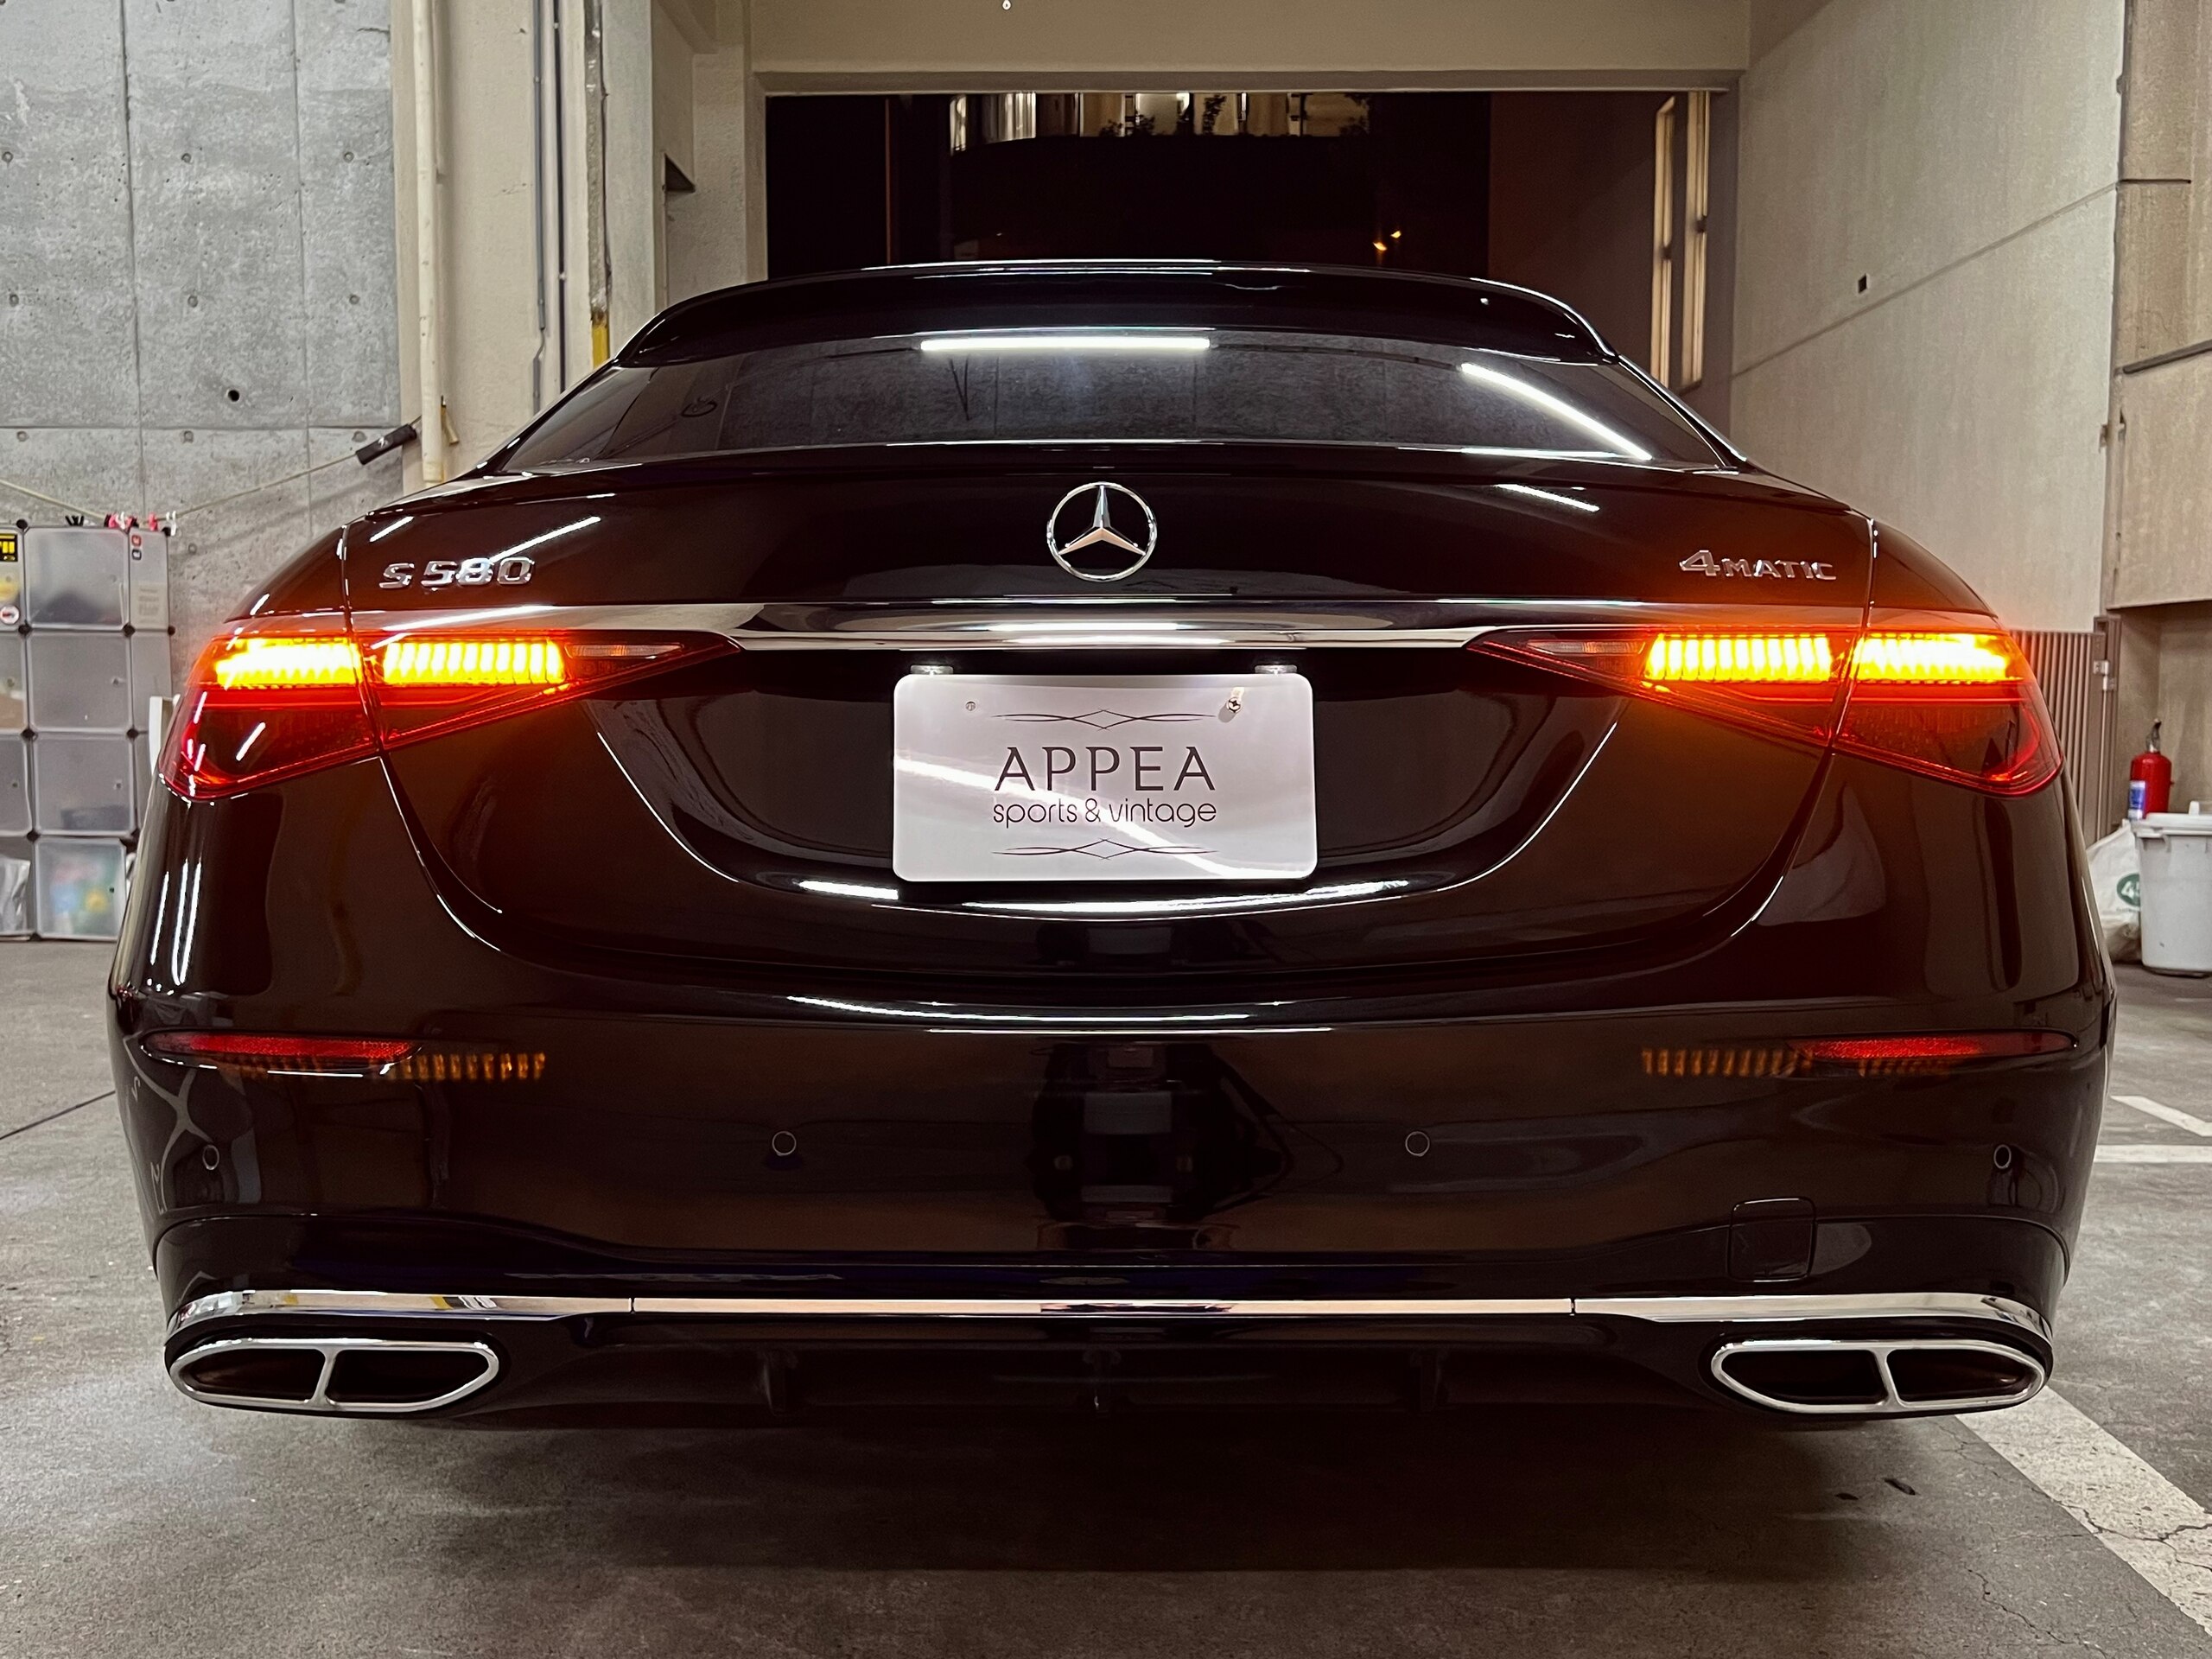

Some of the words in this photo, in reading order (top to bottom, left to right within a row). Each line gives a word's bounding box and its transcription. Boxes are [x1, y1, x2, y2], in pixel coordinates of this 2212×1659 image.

[378, 563, 415, 589] S
[420, 556, 535, 588] 580
[1679, 550, 1837, 581] 4MATIC
[995, 747, 1216, 791] APPEA
[993, 798, 1077, 830] sports
[1084, 798, 1102, 823] &
[1108, 798, 1217, 828] vintage
